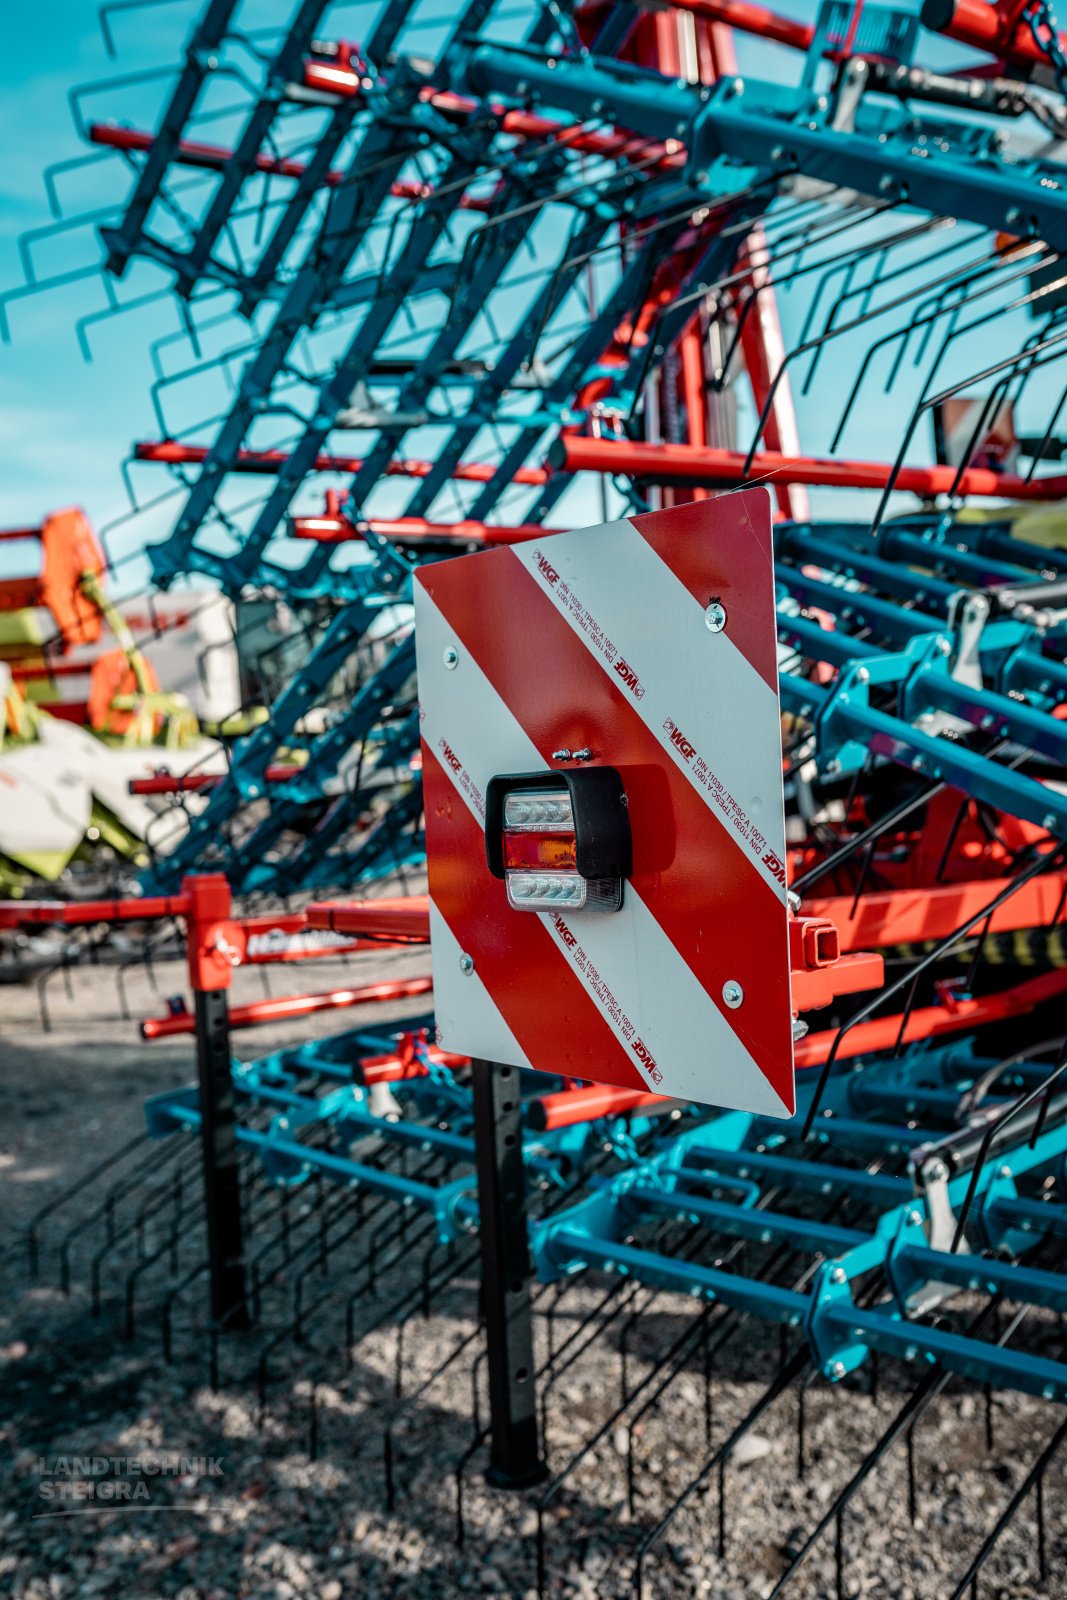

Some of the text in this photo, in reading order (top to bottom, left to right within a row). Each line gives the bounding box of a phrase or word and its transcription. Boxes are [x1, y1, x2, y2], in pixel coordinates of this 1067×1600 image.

[539, 557, 560, 583] WGF
[560, 581, 570, 594] DIN
[569, 592, 582, 610] 11030
[584, 611, 600, 633] TPESC
[604, 638, 618, 656] 10071
[614, 661, 639, 690] WGF
[671, 727, 696, 759] WGF
[444, 746, 462, 771] WGF
[692, 765, 707, 784] 10071
[697, 757, 708, 772] DIN
[708, 772, 723, 792] 11030
[726, 794, 745, 820] TPESC
[750, 826, 767, 848] 10071
[712, 790, 731, 816] TPESC
[734, 818, 750, 840] 11030
[750, 839, 762, 855] DIN
[555, 918, 577, 947] WGF
[574, 953, 586, 972] 10071
[577, 947, 587, 961] DIN
[586, 961, 600, 980] 11030
[602, 984, 618, 1008] TPESC
[622, 1015, 635, 1036] 10071
[590, 978, 606, 1003] TPESC
[608, 1006, 621, 1026] 11030
[621, 1026, 632, 1041] DIN
[631, 1041, 656, 1073] WGF
